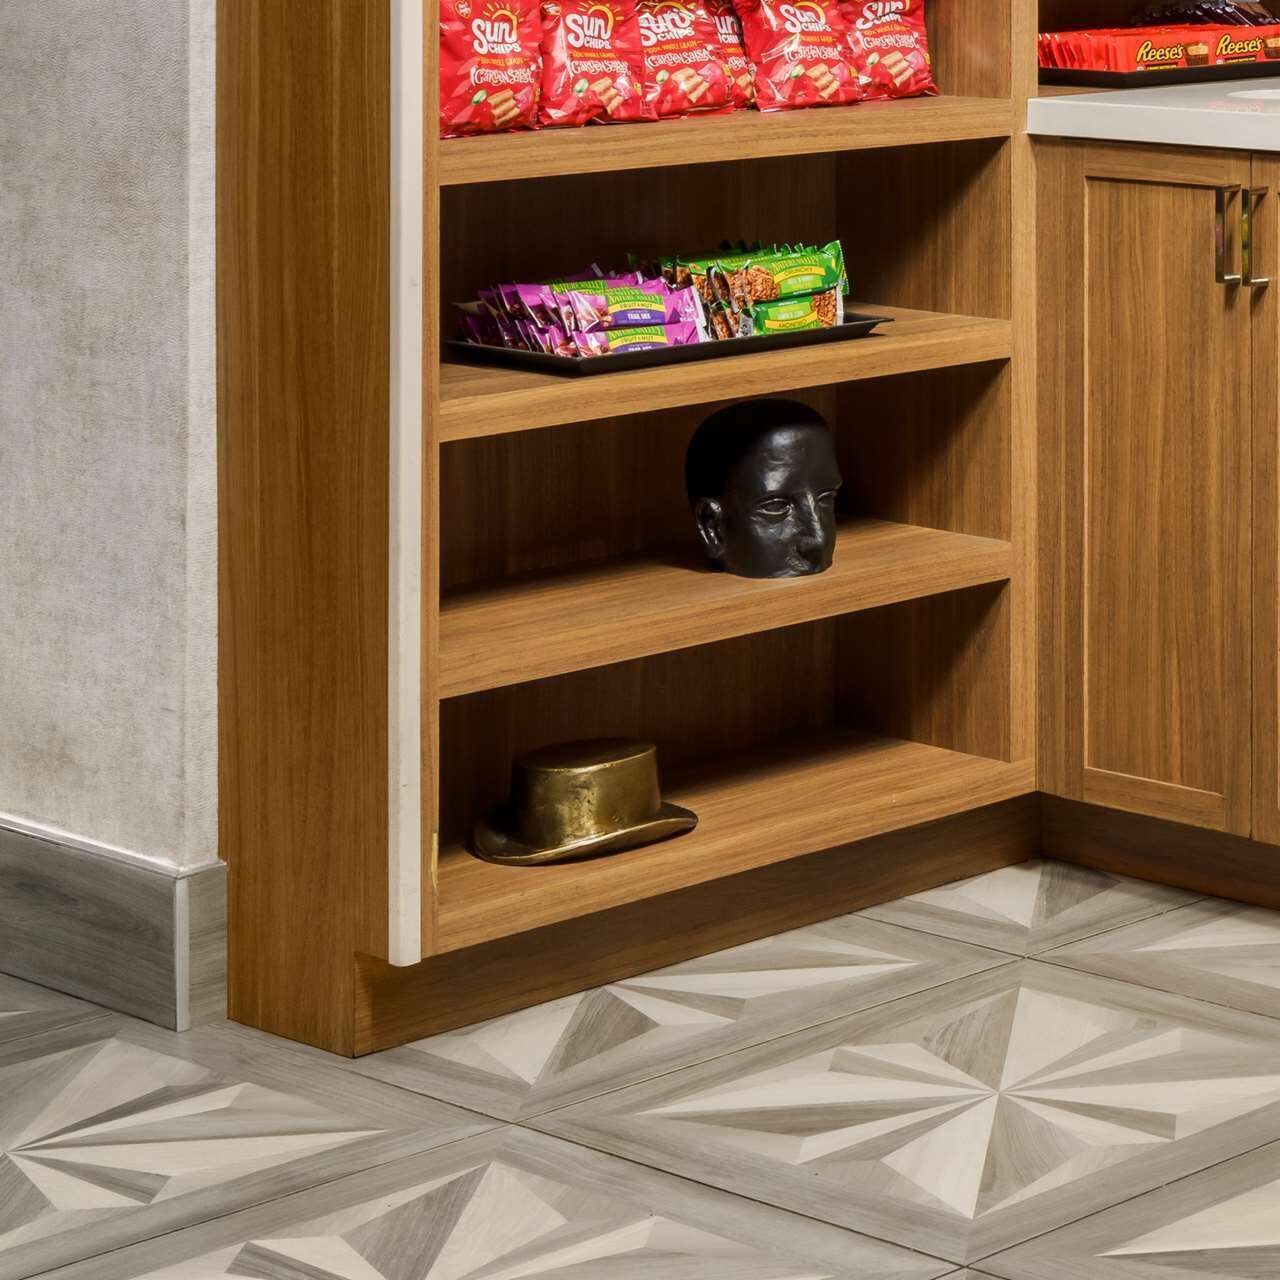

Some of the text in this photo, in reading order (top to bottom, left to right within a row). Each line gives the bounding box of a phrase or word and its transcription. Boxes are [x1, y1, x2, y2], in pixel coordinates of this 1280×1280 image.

[714, 15, 739, 34] un
[656, 26, 695, 41] CHIPS
[486, 42, 522, 54] CHIPS
[583, 38, 612, 50] CHIPS
[1136, 40, 1184, 62] Reese's
[1216, 34, 1263, 56] Reese's
